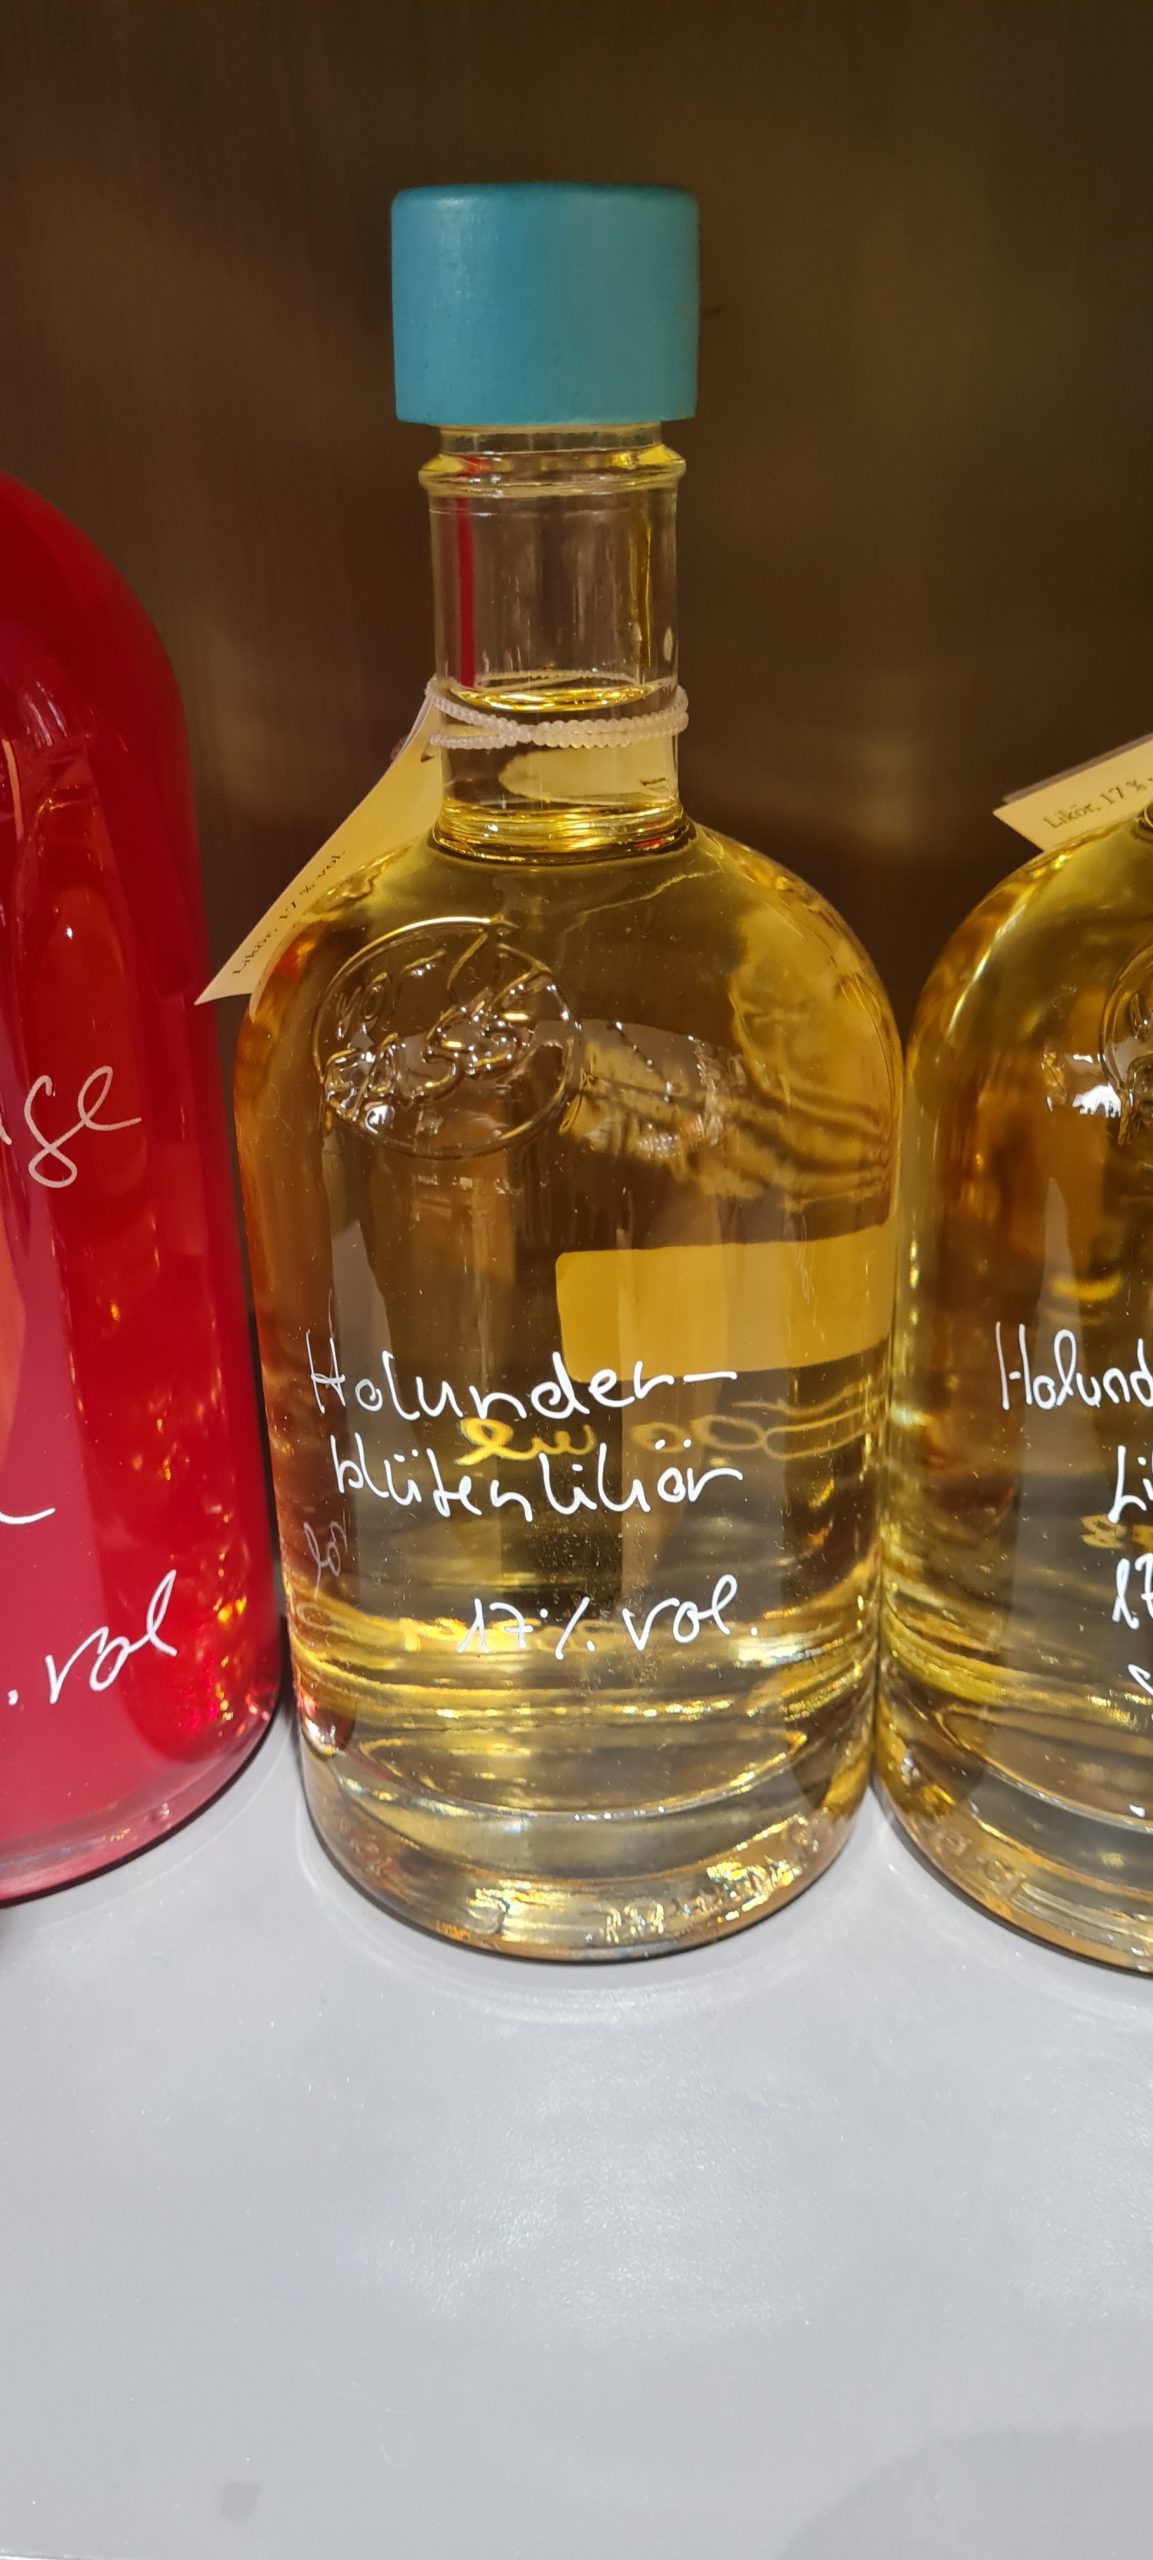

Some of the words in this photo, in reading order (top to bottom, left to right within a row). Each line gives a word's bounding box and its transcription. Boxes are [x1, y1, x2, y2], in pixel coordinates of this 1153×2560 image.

[1043, 803, 1101, 829] Likör,
[1100, 785, 1124, 805] 17
[1126, 778, 1147, 793] %
[0, 1066, 142, 1188] ge
[304, 1329, 738, 1421] Holunder-
[1107, 1445, 1153, 1524] Li
[622, 1573, 760, 1651] vol.
